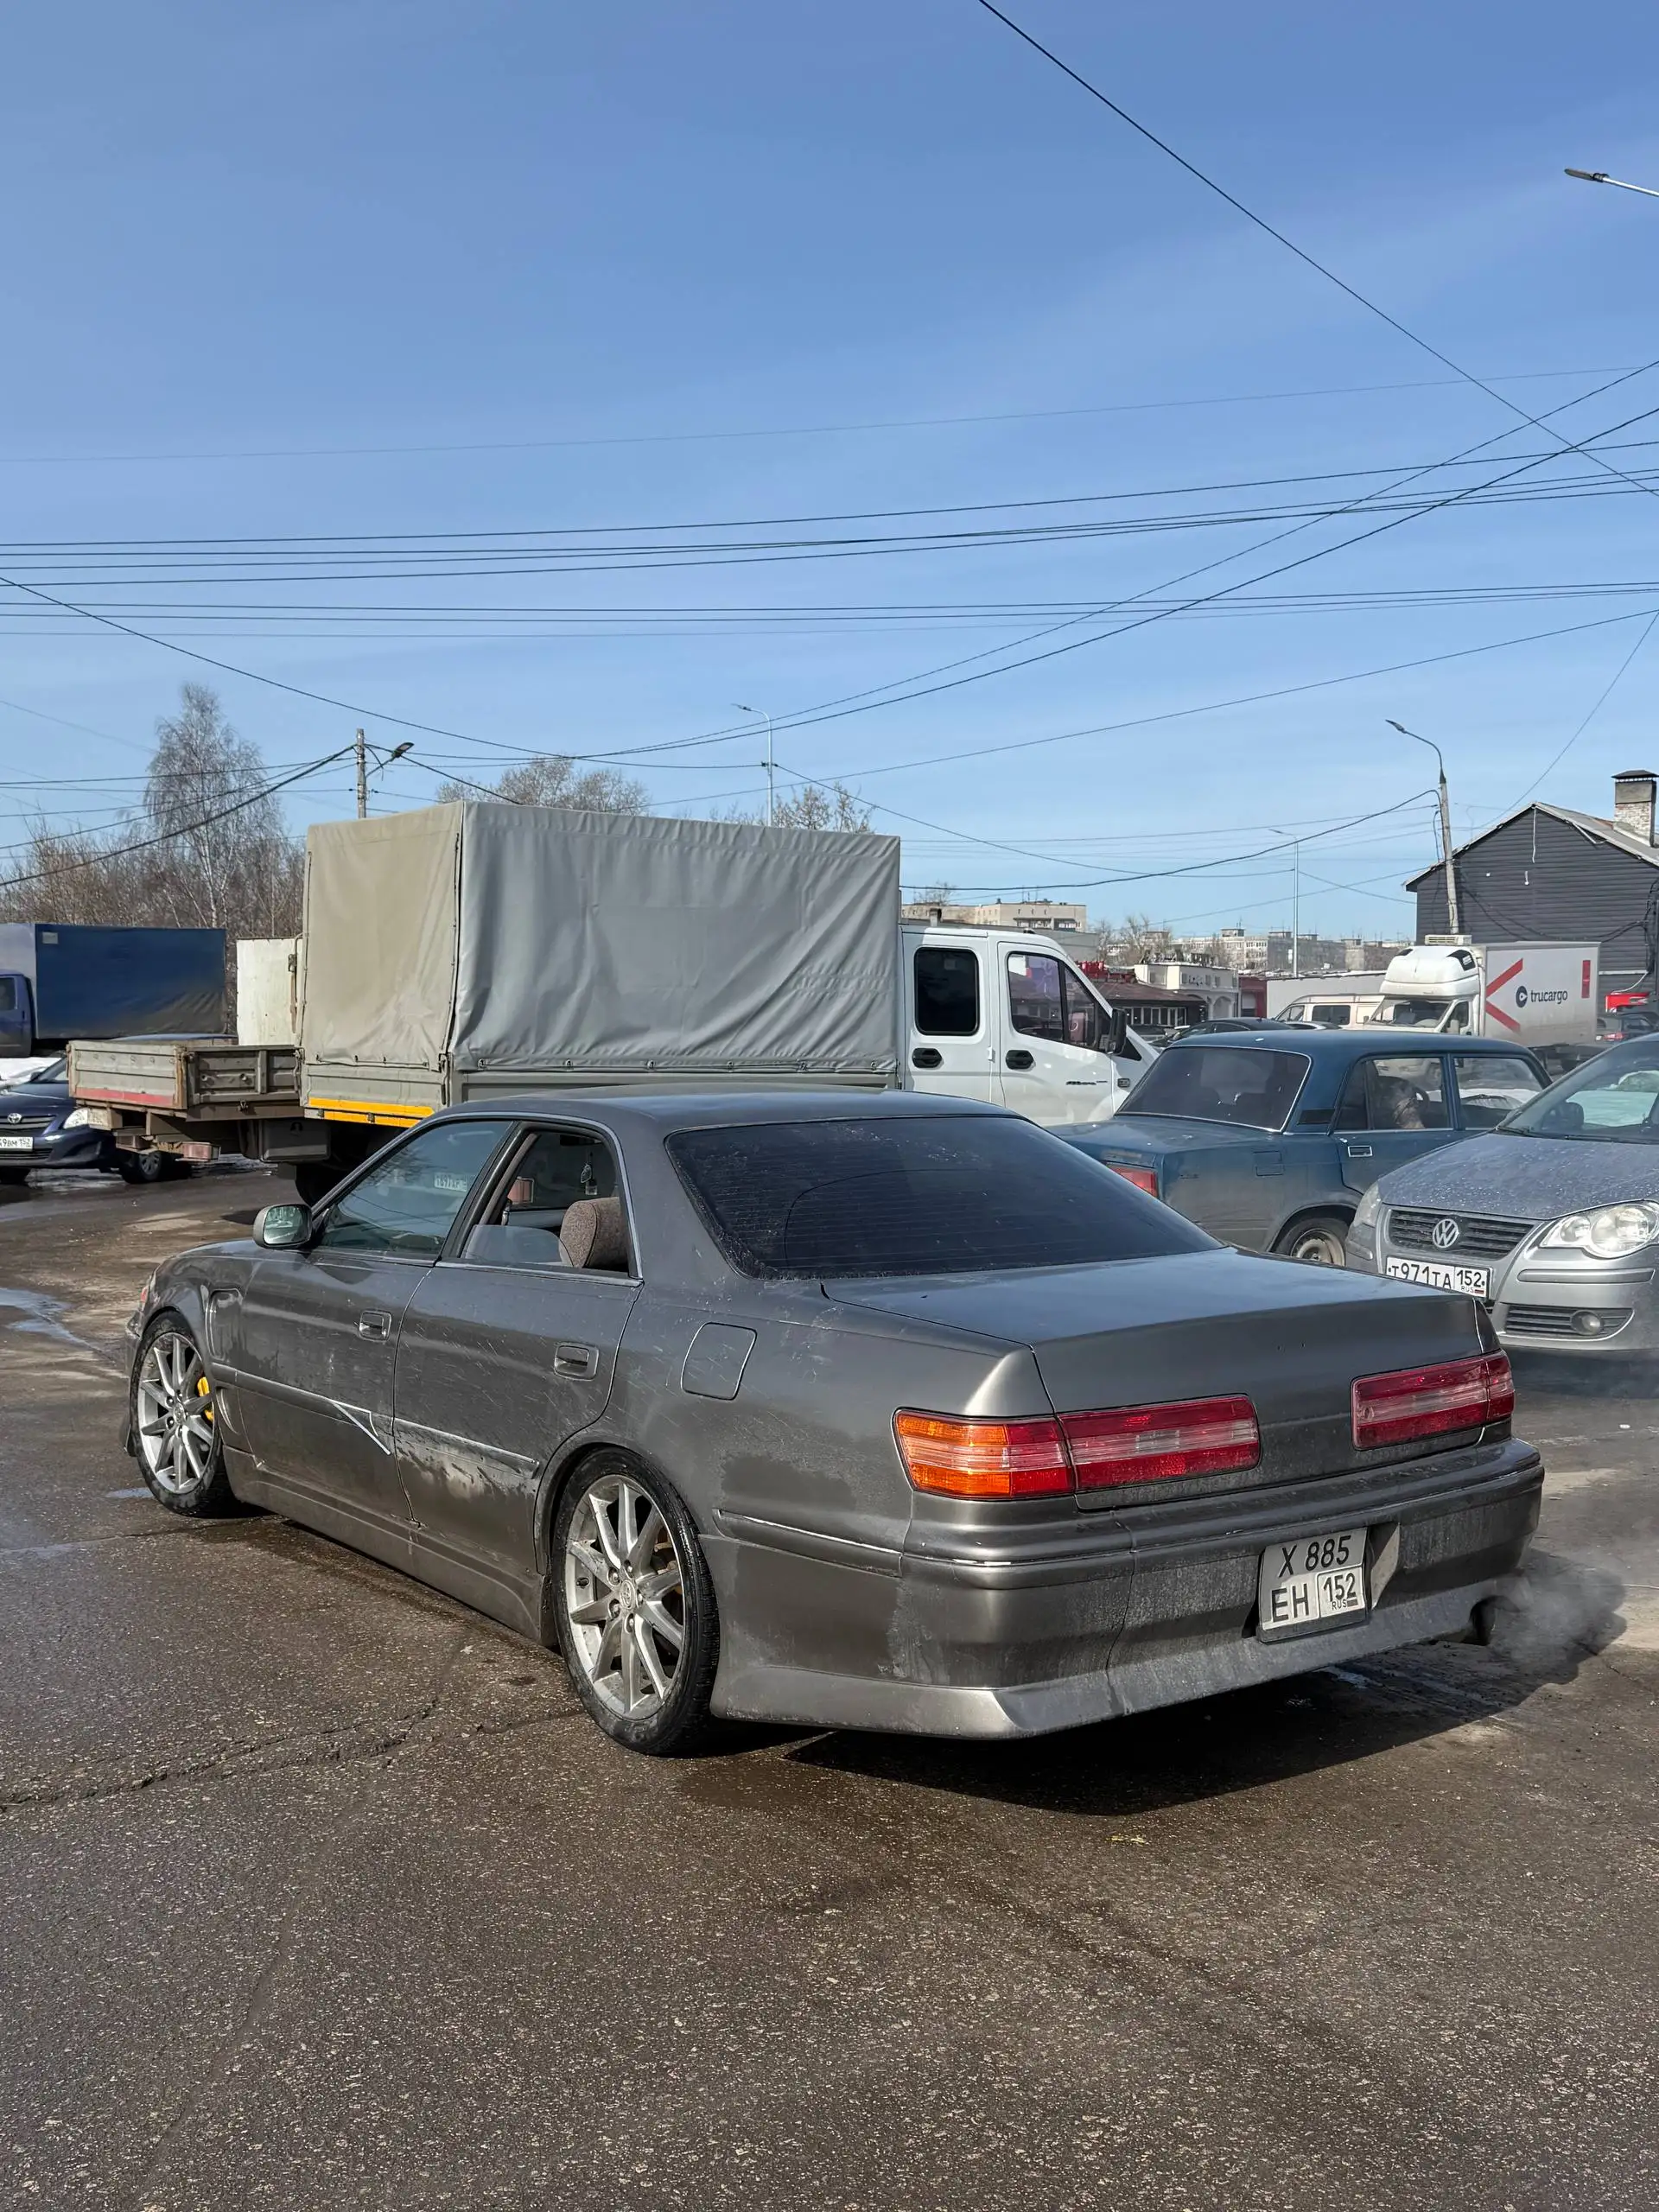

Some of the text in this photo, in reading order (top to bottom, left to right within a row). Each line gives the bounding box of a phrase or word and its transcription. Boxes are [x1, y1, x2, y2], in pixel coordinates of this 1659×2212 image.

[1530, 989, 1568, 1005] trucargo
[1457, 1269, 1482, 1287] 152
[1305, 1535, 1351, 1571] 885
[1323, 1573, 1357, 1602] 152
[1332, 1599, 1347, 1610] RUS
